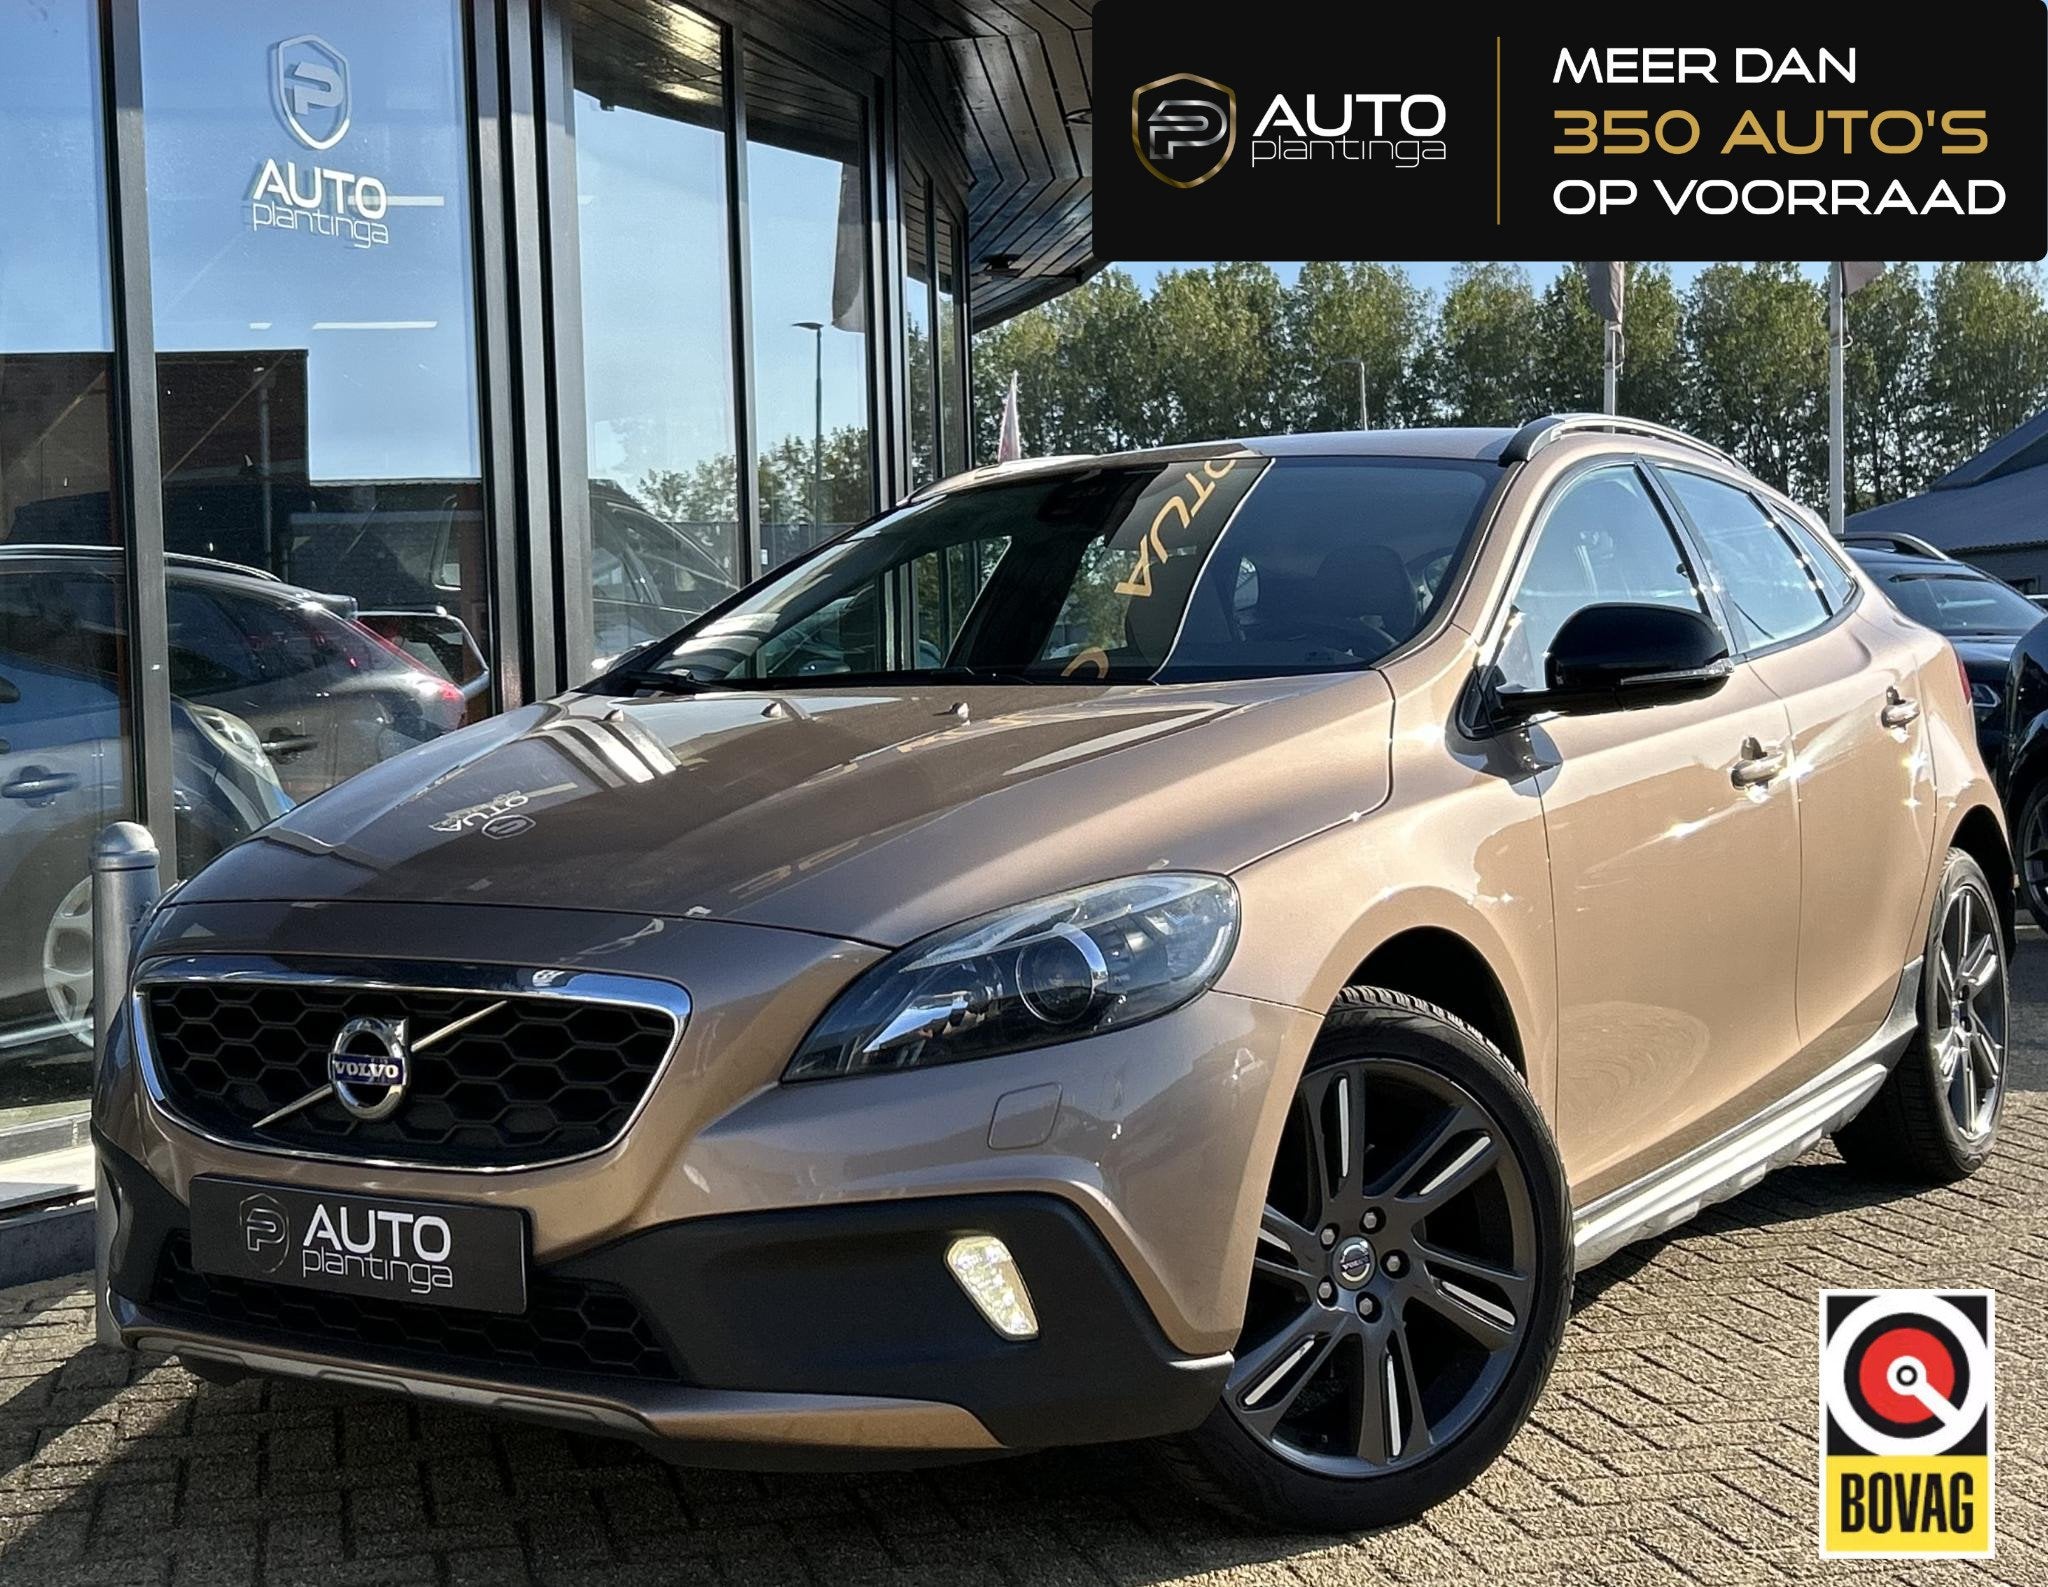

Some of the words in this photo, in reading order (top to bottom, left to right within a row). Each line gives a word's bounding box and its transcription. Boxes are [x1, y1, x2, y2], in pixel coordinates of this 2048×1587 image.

[253, 158, 388, 220] AUTO
[252, 201, 389, 249] plantinga
[334, 1060, 399, 1079] VOLVO
[302, 1203, 451, 1262] AUTO
[302, 1246, 453, 1293] plantinga
